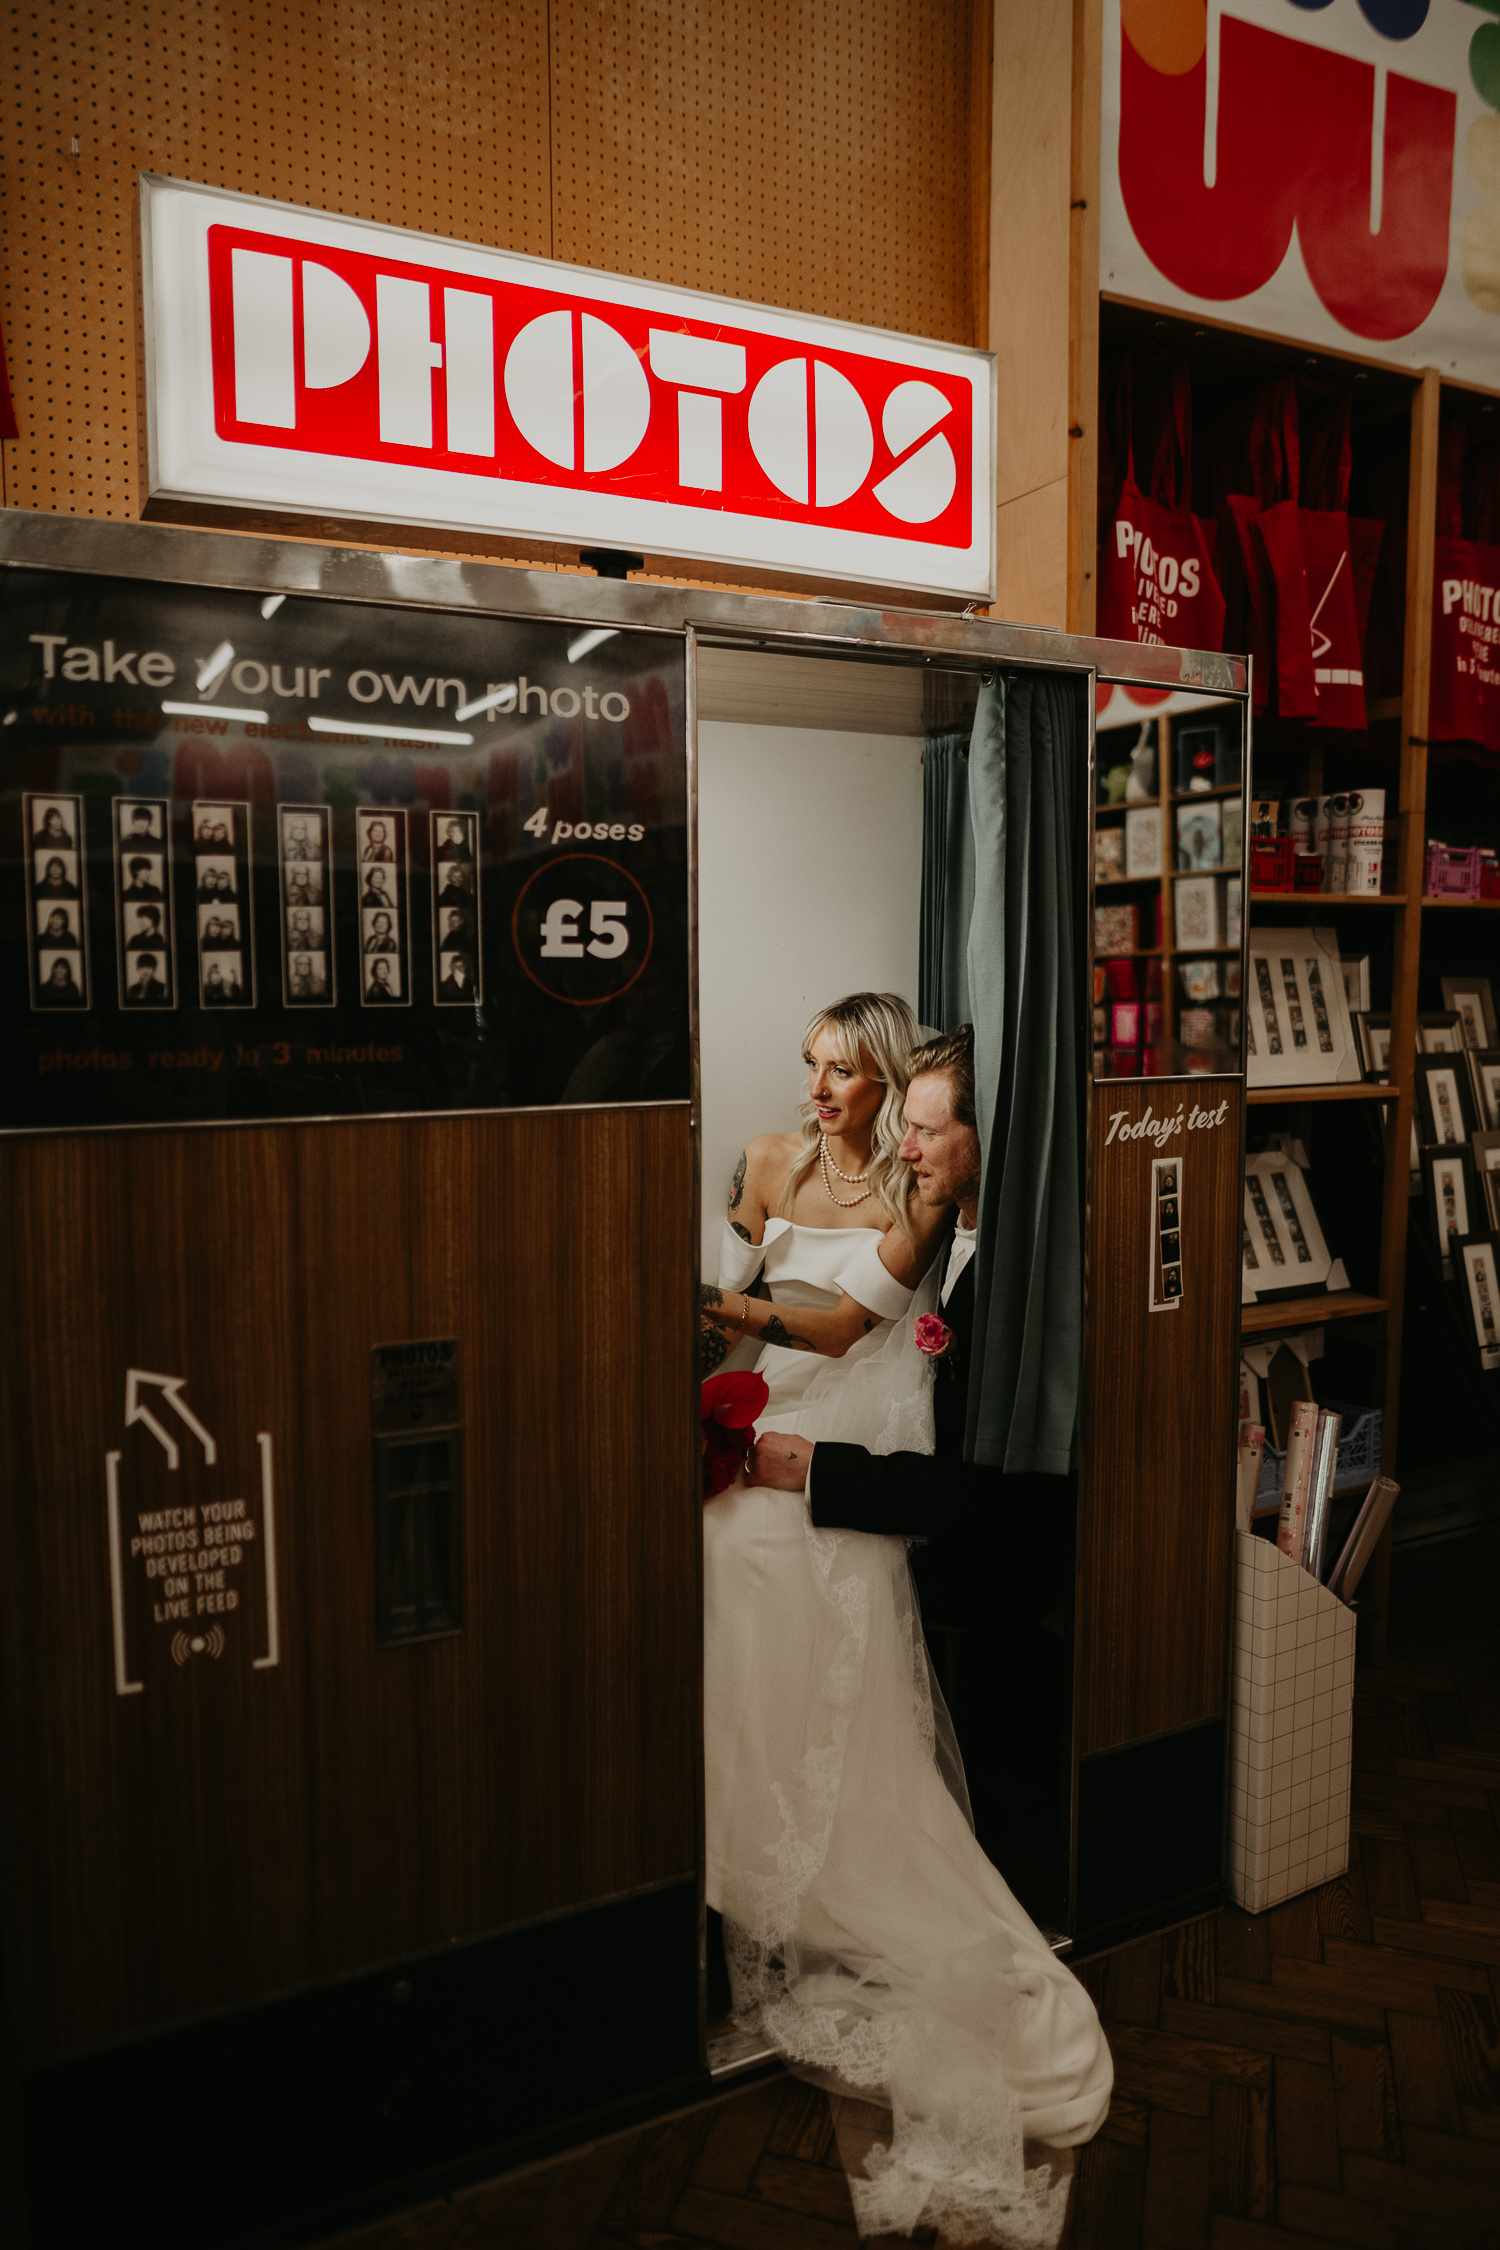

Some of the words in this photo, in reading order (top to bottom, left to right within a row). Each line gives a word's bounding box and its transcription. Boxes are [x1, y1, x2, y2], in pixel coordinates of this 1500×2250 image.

[232, 247, 956, 524] PHOTOS
[28, 634, 176, 687] Take
[347, 669, 467, 708] own
[486, 676, 631, 722] photo
[32, 704, 96, 728] with
[114, 707, 158, 733] the
[174, 716, 229, 736] new
[523, 807, 549, 838] 4
[551, 819, 646, 845] poses
[540, 898, 630, 960] £5
[37, 1046, 133, 1075] photos
[150, 1046, 223, 1073] ready
[271, 1042, 292, 1065] 3
[306, 1042, 405, 1065] minutes
[1104, 1103, 1184, 1148] Today's
[1186, 1100, 1230, 1131] test
[138, 1505, 197, 1533] WATCH
[200, 1498, 247, 1523] YOUR
[131, 1527, 199, 1558] PHOTOS
[203, 1519, 256, 1547] BEING
[145, 1544, 243, 1578] DEVELOPED
[163, 1576, 190, 1598] ON
[194, 1569, 226, 1593] THE
[153, 1597, 190, 1623] LIVE
[195, 1589, 239, 1616] FEED
